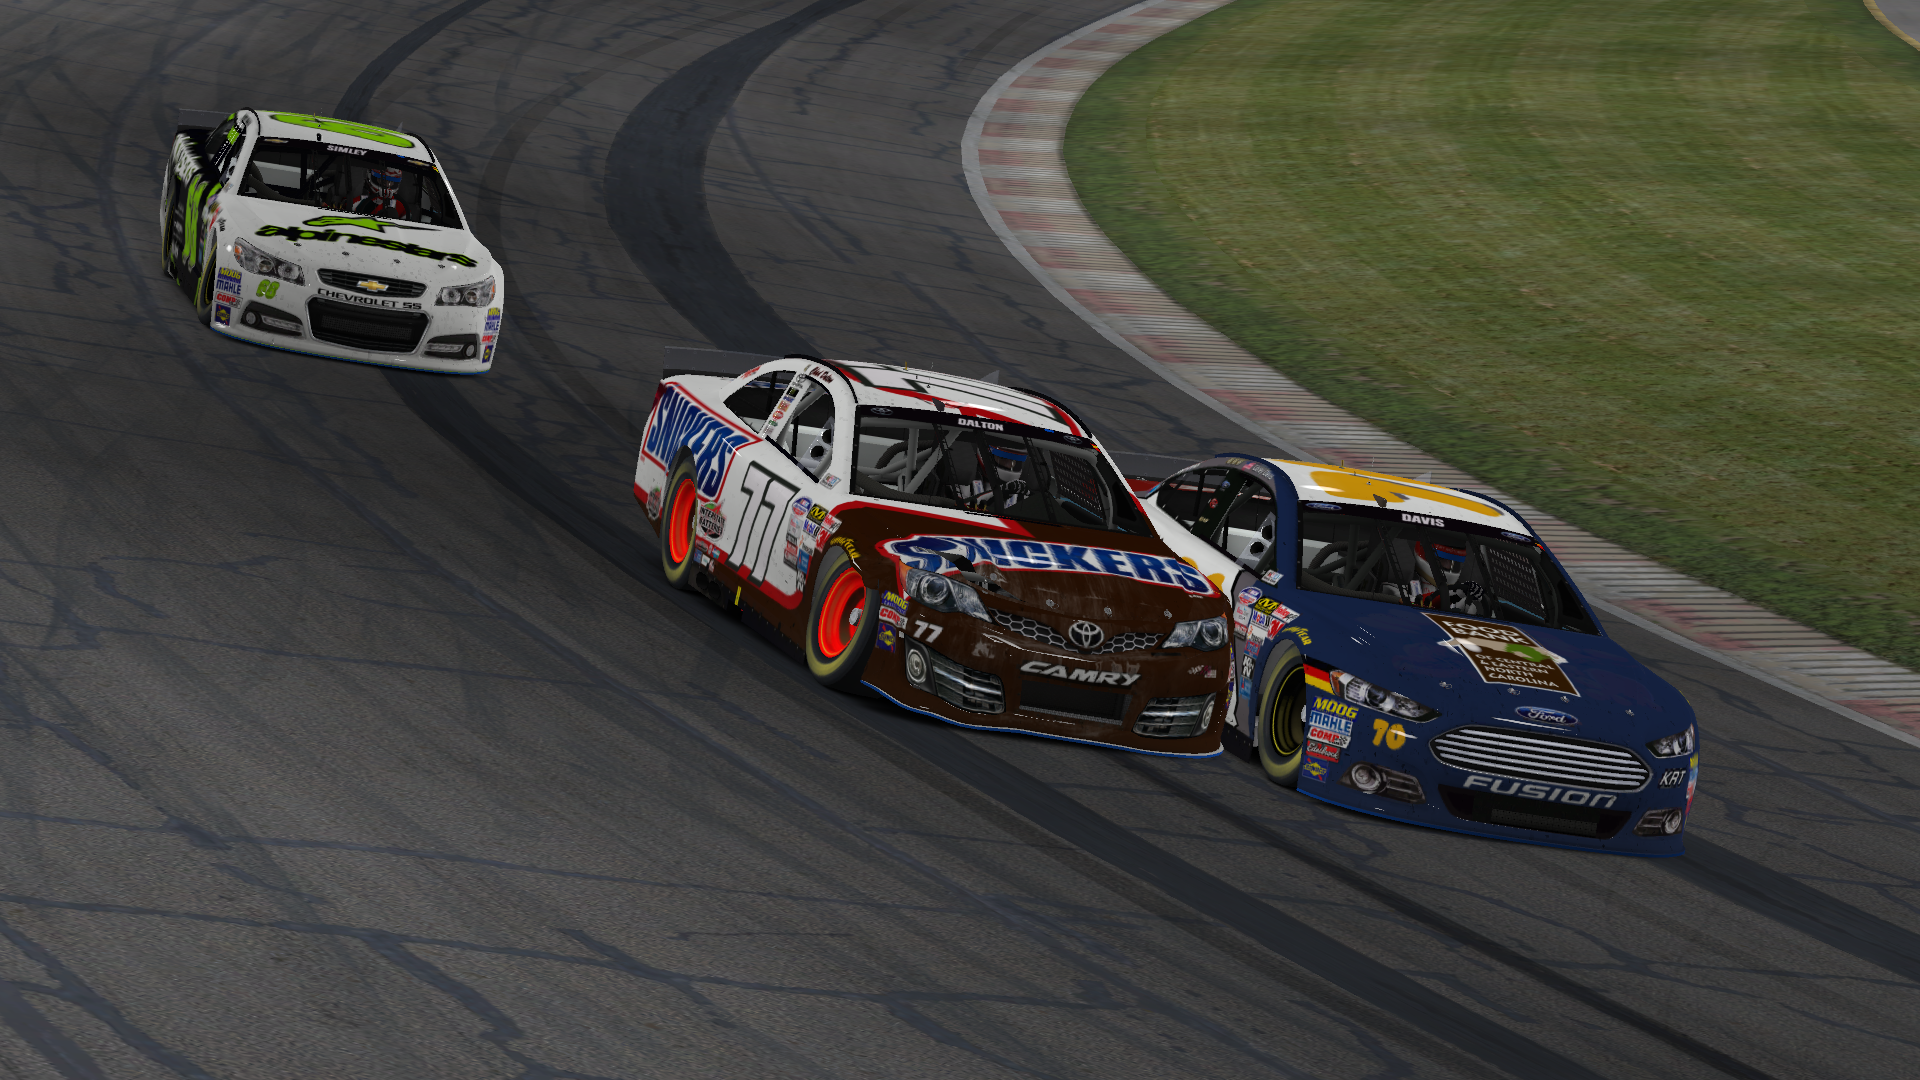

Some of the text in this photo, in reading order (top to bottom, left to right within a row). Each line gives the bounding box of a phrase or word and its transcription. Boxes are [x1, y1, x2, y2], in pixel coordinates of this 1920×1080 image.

[327, 145, 368, 156] SIMLEY
[216, 280, 242, 295] MAHLE
[317, 288, 422, 310] CHEVROLET SS
[957, 418, 1004, 431] DALTON
[699, 506, 726, 526] INTERSTATE
[1401, 513, 1445, 528] DAVIS
[883, 591, 909, 610] MOOG
[913, 619, 944, 643] 77
[1281, 626, 1312, 646] YEAR
[1441, 620, 1520, 636] FOOD
[1451, 627, 1530, 645] BANK
[1475, 653, 1555, 670] OF CENTRAL
[1491, 661, 1549, 675] EASTERN
[1020, 660, 1141, 686] CAMRY
[1484, 666, 1534, 678] NORTH
[1488, 672, 1560, 688] CAROLINA
[1313, 697, 1359, 719] MOOG
[1528, 708, 1567, 723] Ford
[1310, 711, 1352, 733] MAHLE
[1310, 728, 1340, 743] COMP
[1372, 718, 1407, 750] 70
[1307, 742, 1340, 760] Edelbrock
[1463, 774, 1617, 808] FUSION
